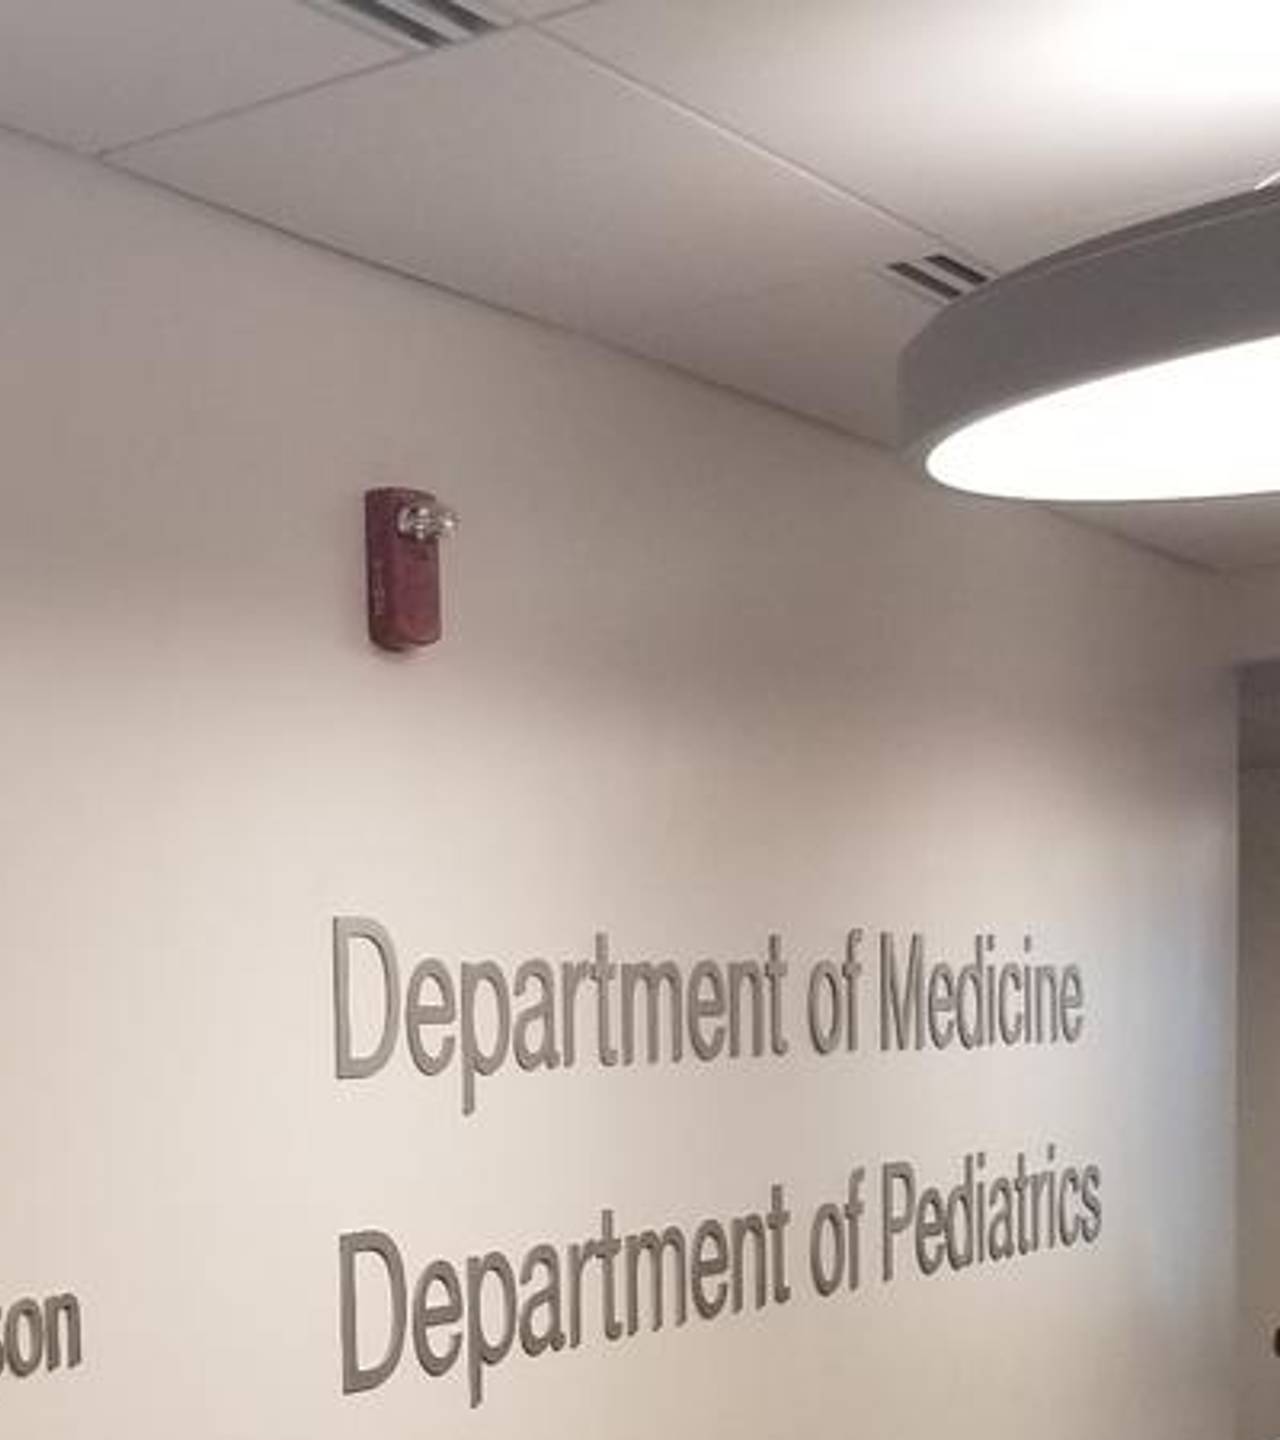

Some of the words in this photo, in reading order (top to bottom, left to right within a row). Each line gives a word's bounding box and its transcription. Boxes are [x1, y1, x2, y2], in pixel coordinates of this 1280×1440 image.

[332, 916, 788, 1115] Department
[806, 928, 864, 1054] of
[879, 931, 1085, 1052] Medicine
[338, 1183, 791, 1408] Department
[809, 1167, 866, 1299] of
[882, 1143, 1102, 1281] Pediatrics
